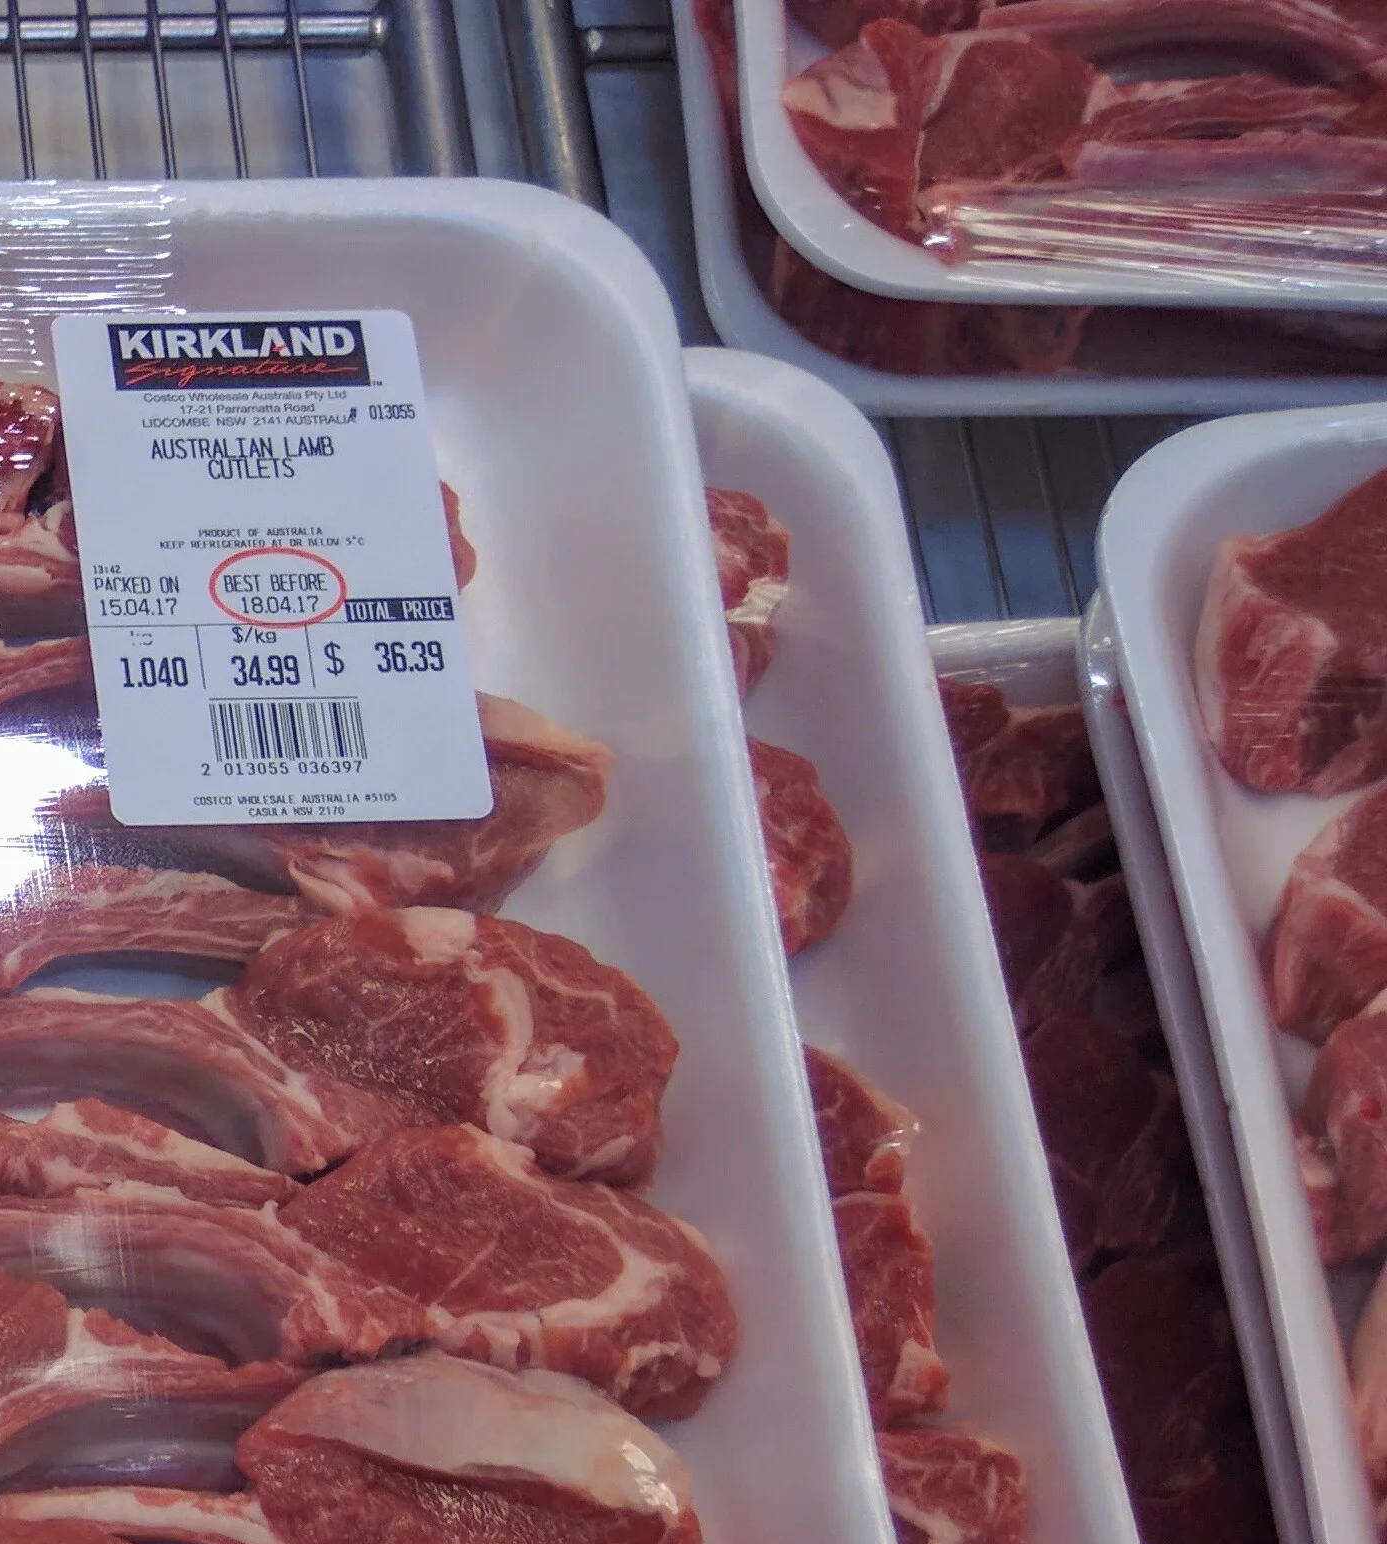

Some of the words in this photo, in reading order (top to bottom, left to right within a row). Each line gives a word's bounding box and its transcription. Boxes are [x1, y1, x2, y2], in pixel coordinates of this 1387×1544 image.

[118, 327, 355, 360] KIRKLAND
[124, 358, 359, 388] Signature
[144, 393, 185, 403] Costco
[188, 392, 250, 402] Wholesale
[252, 391, 303, 400] Australia
[305, 391, 325, 401] Pty
[327, 390, 346, 399] Ltd
[180, 406, 212, 414] 17-21
[216, 404, 281, 414] Parramatta
[284, 403, 314, 412] Road
[369, 404, 415, 419] 013055
[143, 418, 210, 428] LIDCOMBE
[216, 417, 246, 426] NSW
[253, 417, 281, 426] 2141
[286, 415, 357, 425] AUSTRALIA
[152, 438, 273, 460] AUSTRALIAN
[284, 437, 334, 457] LAMB
[208, 458, 295, 479] CUTLETS
[198, 529, 240, 538] PRODUCT
[248, 528, 259, 537] OF
[267, 527, 322, 536] AUSTRALIA
[159, 541, 185, 549] KEEP
[190, 539, 265, 549] REFRIGERATED
[271, 539, 283, 547] AT
[289, 538, 302, 547] OR
[308, 538, 339, 546] BELOW
[93, 565, 121, 574] 13:42
[159, 576, 179, 593] ON
[224, 575, 261, 593] BEST
[271, 573, 327, 591] BEFORE
[100, 599, 177, 616] 15.04.17
[241, 597, 319, 614] 18.04.17
[348, 601, 397, 621] TOTAL
[402, 599, 451, 619] PRICE
[232, 626, 276, 644] $/kg
[325, 642, 345, 675] $
[375, 641, 444, 672] 36.39
[120, 657, 188, 687] 1.040
[231, 655, 300, 686] 34.99
[201, 763, 210, 776] 2
[224, 762, 289, 775] 013055
[298, 760, 361, 774] 036397
[194, 796, 232, 806] COSTCO
[238, 795, 295, 804] WHOLESALE
[302, 793, 359, 803] AUSTRALIA
[249, 808, 287, 817] CASULA
[294, 807, 313, 816] NSW
[319, 806, 344, 815] 2170
